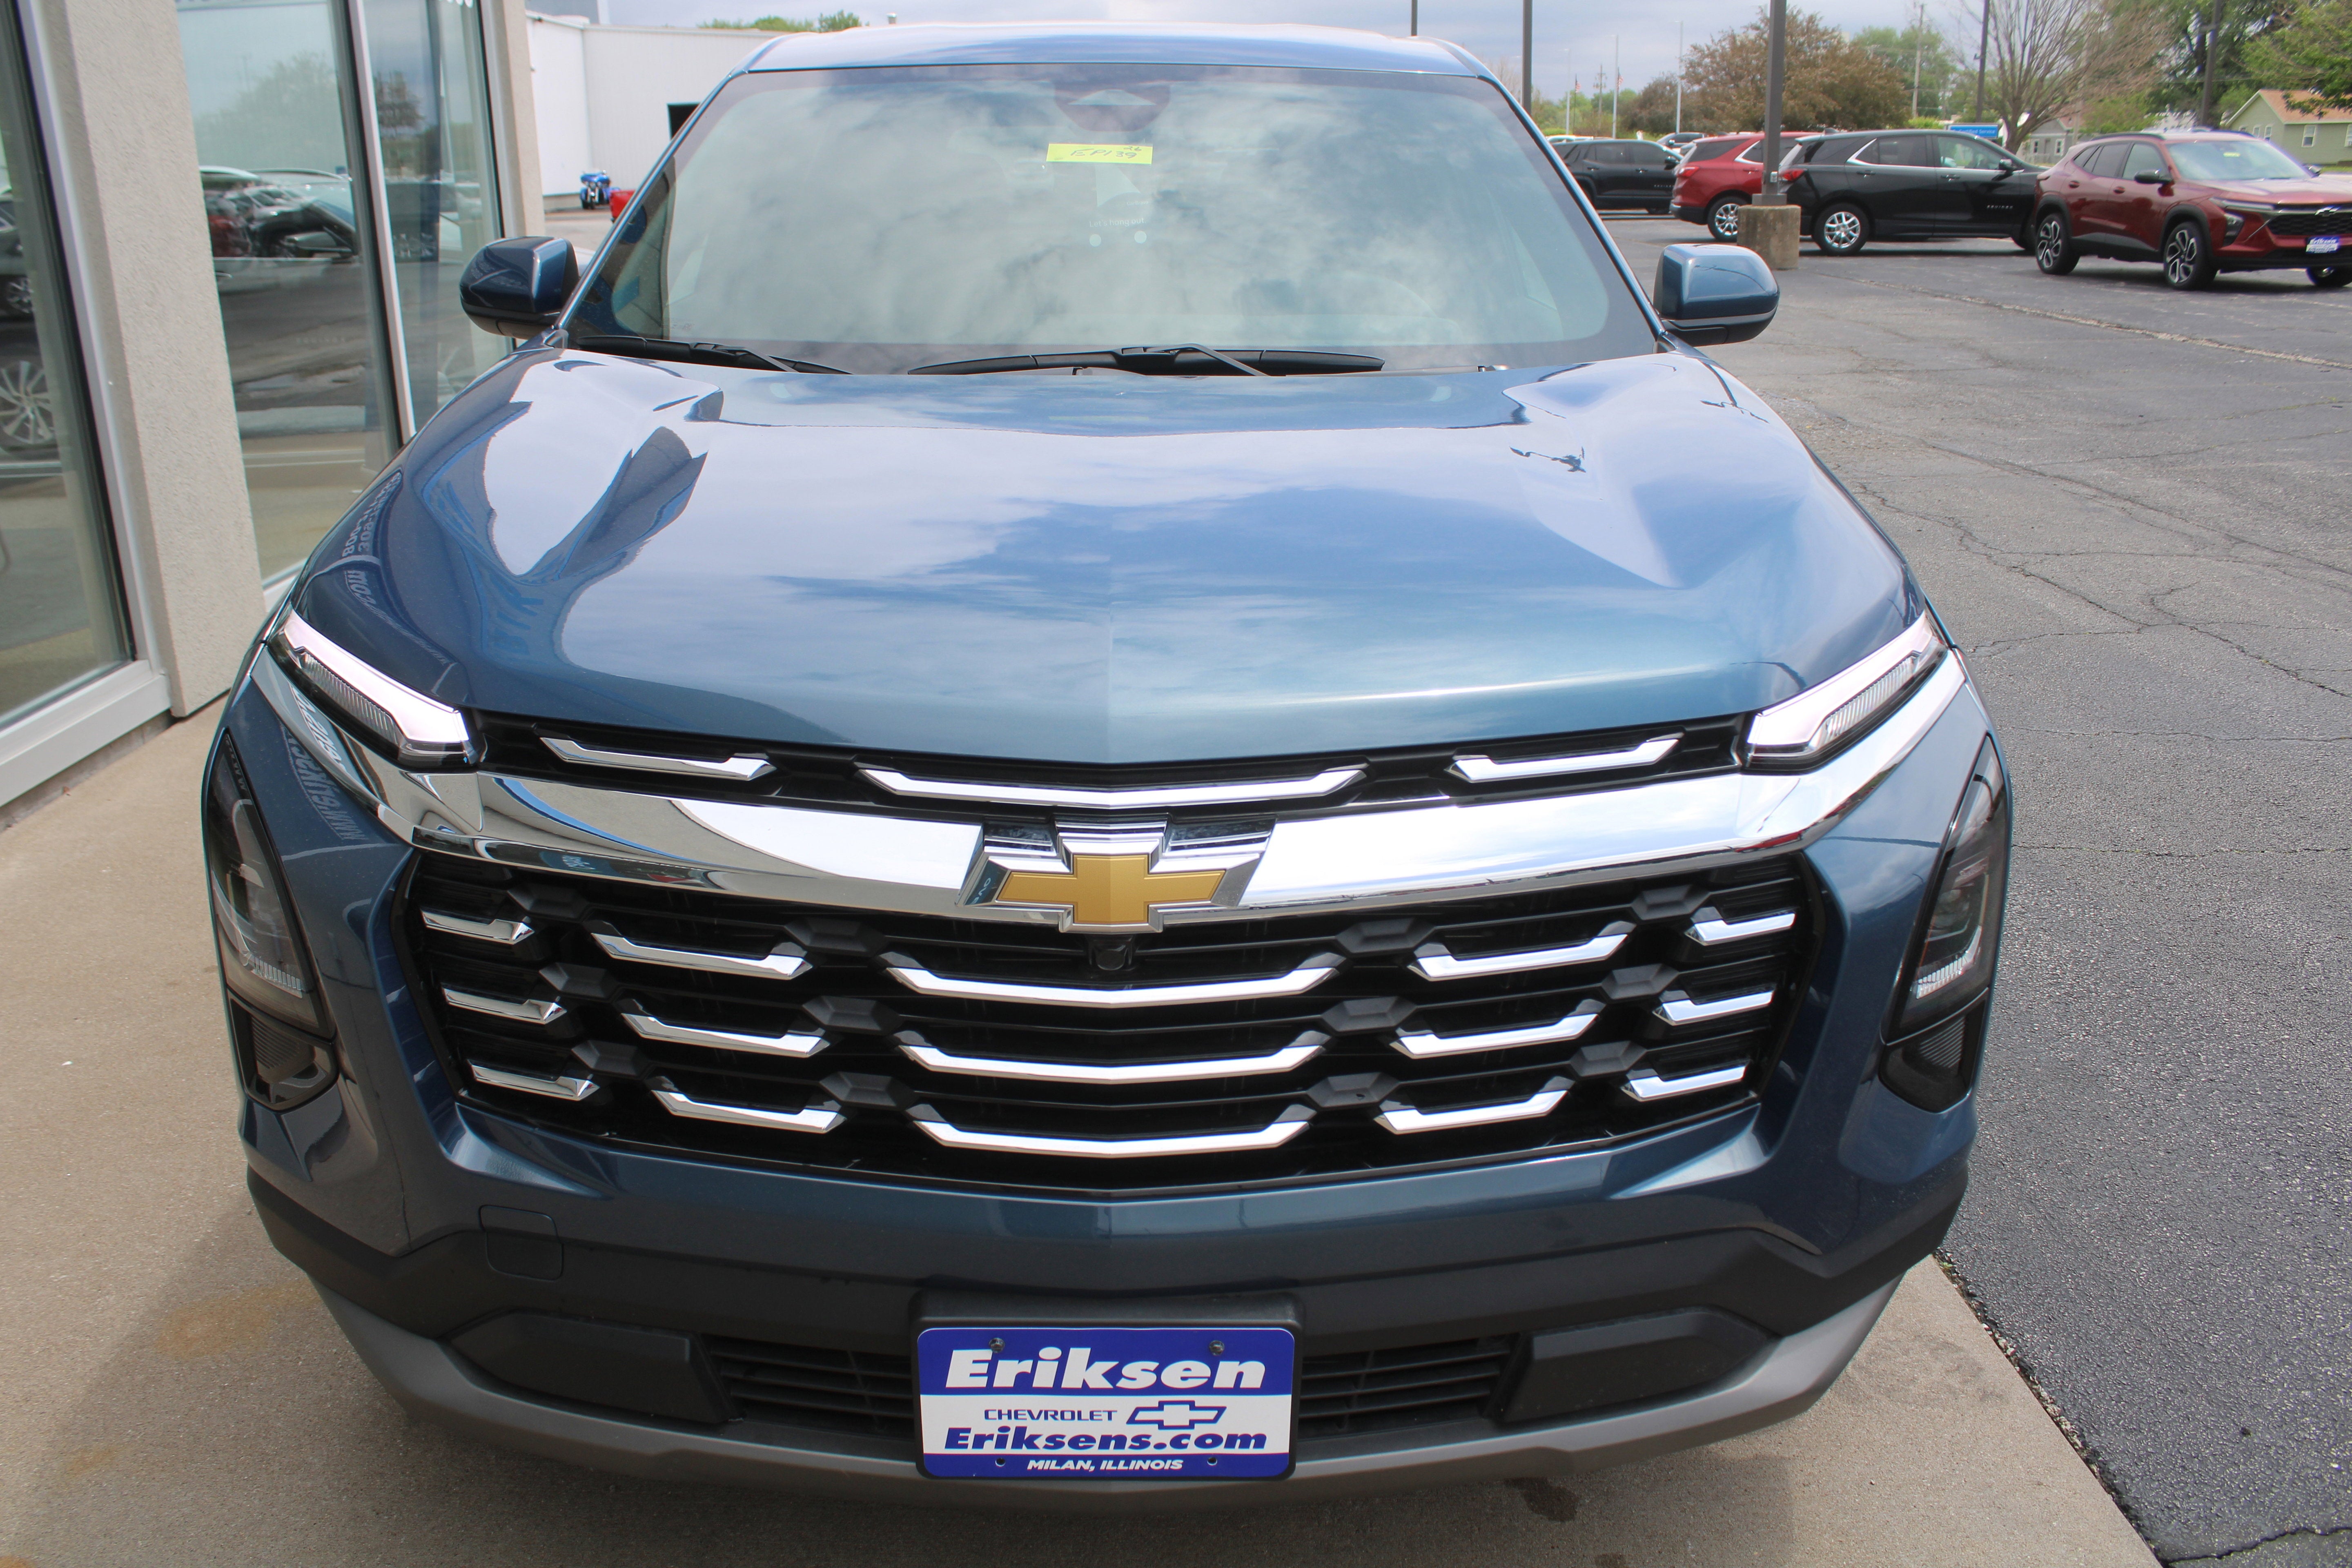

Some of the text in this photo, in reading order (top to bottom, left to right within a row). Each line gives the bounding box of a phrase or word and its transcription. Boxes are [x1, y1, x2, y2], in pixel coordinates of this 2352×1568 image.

[945, 1347, 1266, 1389] Eriksen
[984, 1409, 1118, 1421] CHEVROLET
[944, 1425, 1267, 1450] Eriksens.com
[1027, 1459, 1183, 1472] MILAN, ILLINOIS
